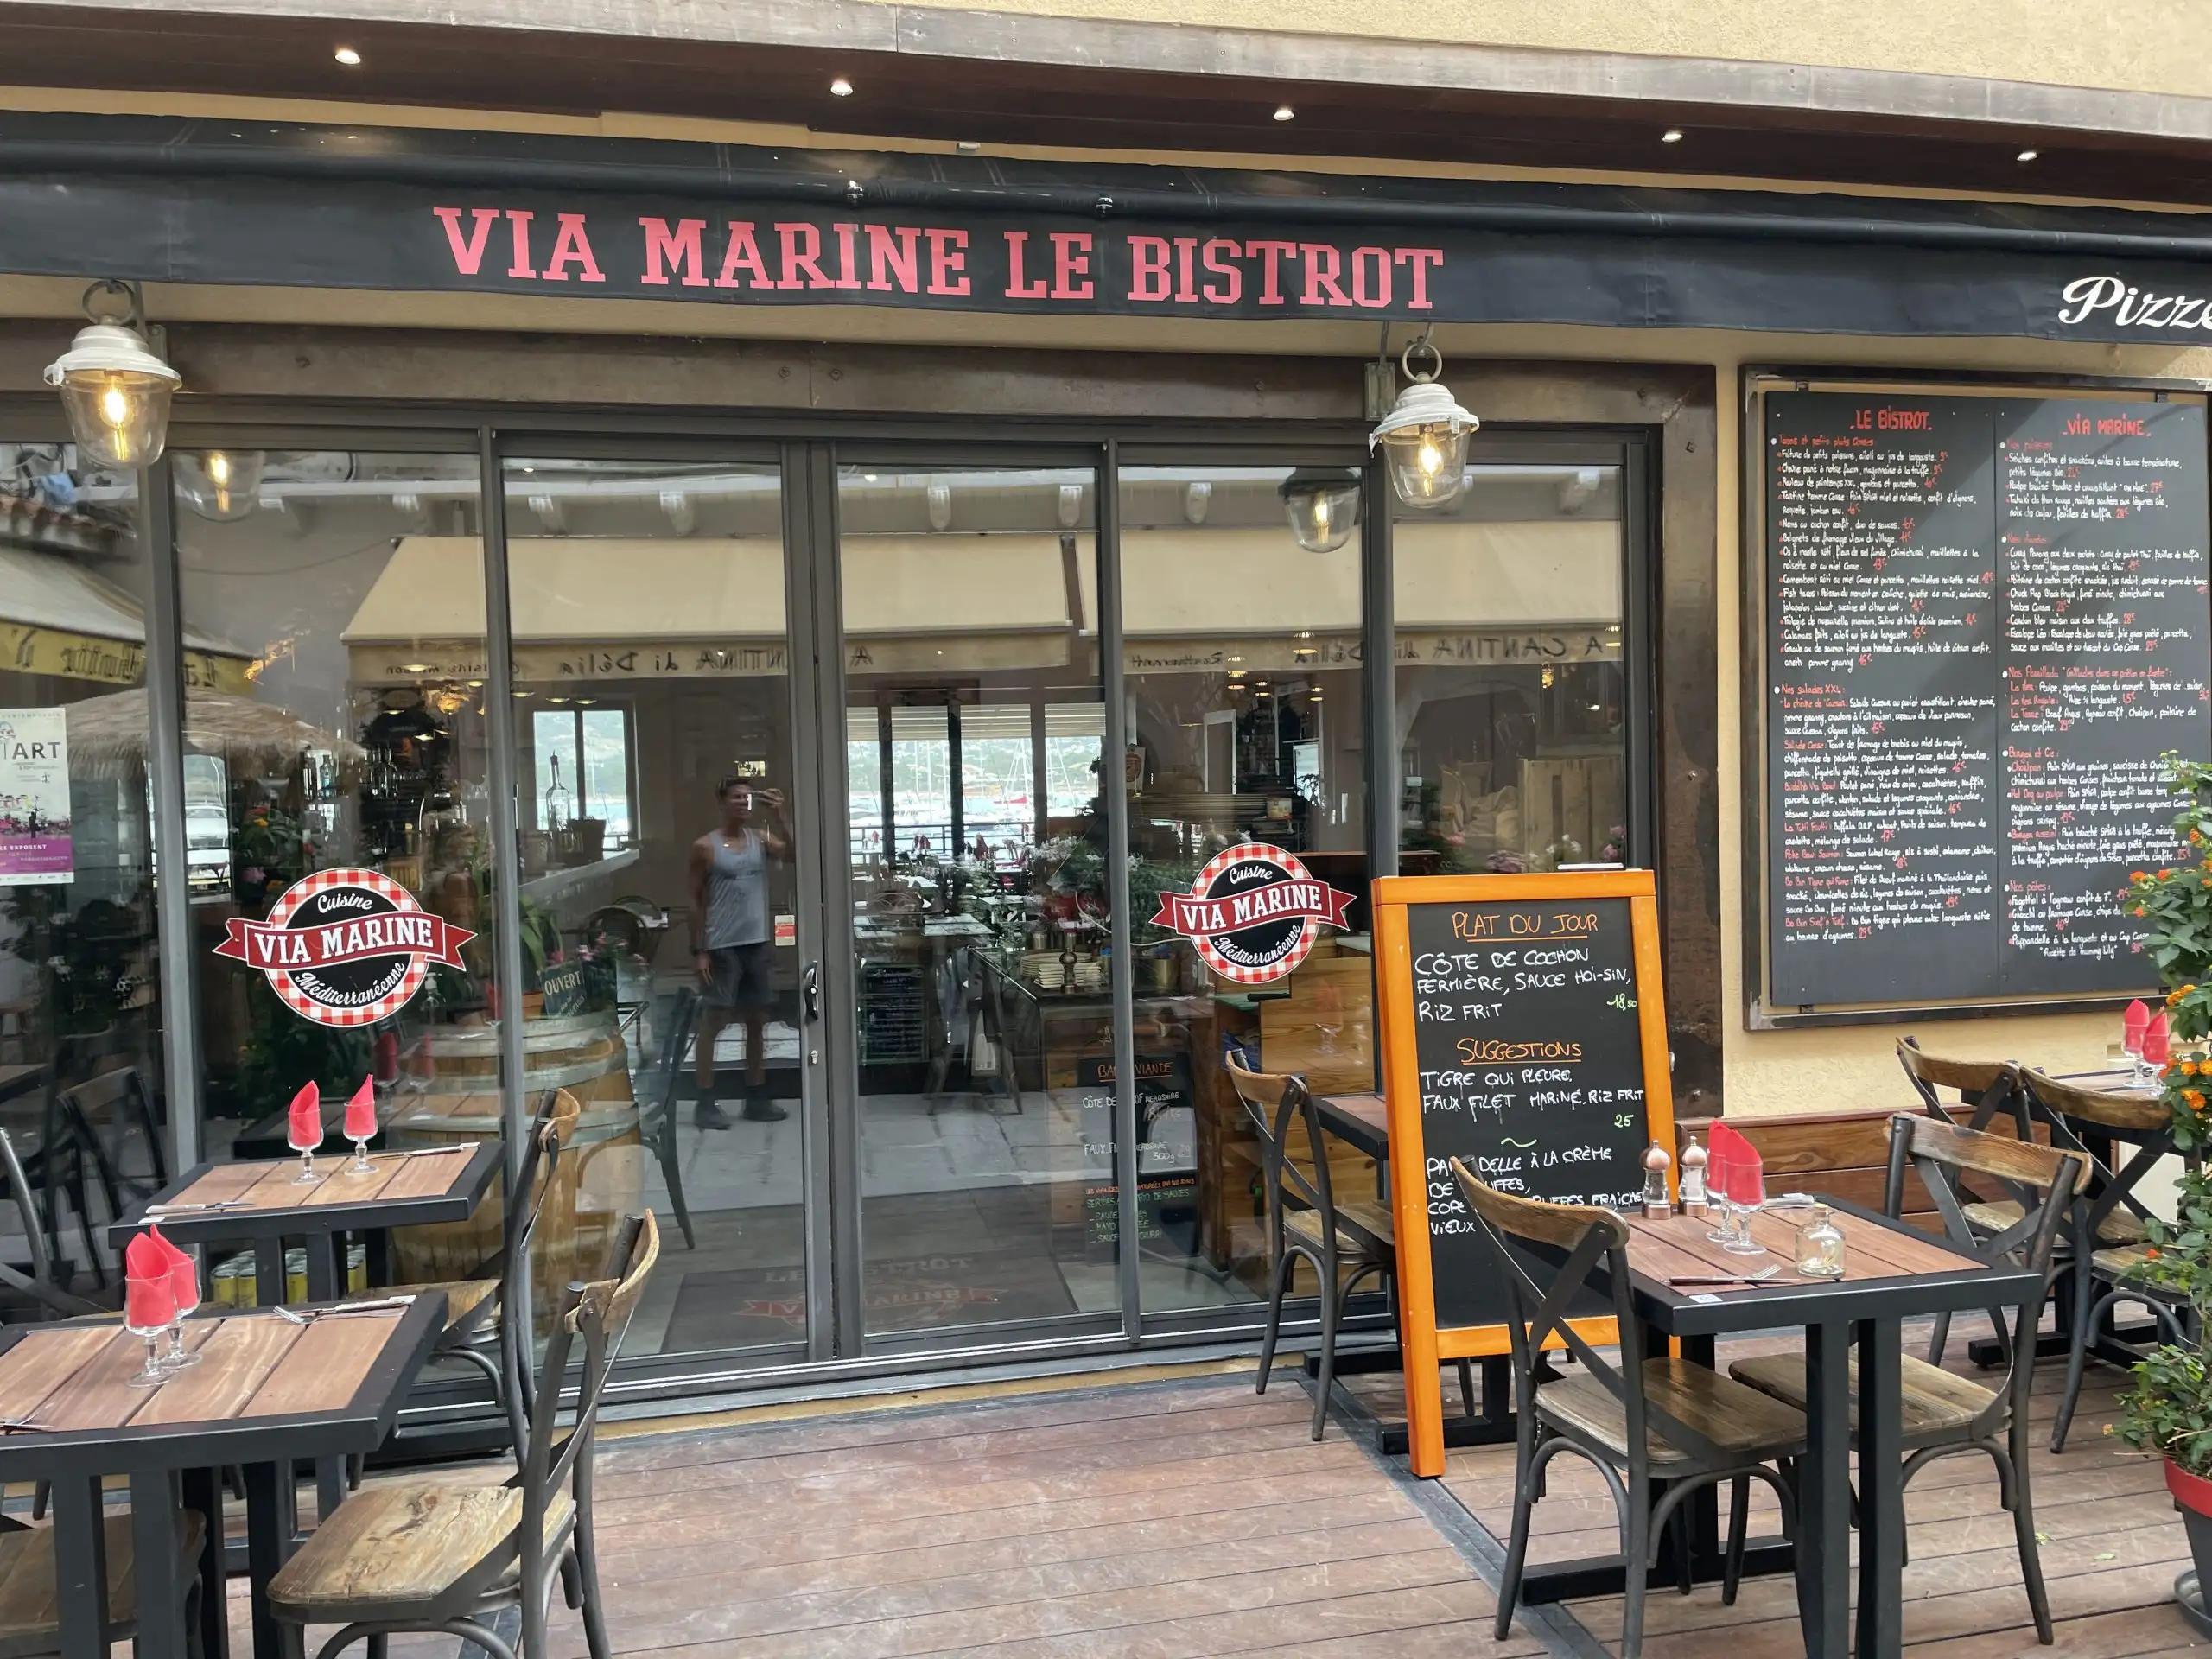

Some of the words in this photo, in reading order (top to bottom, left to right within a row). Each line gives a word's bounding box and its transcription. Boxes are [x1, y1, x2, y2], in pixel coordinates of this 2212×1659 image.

[434, 207, 606, 283] VIA
[639, 217, 971, 296] MARINE
[1003, 231, 1094, 300] LE
[1127, 235, 1444, 310] BISTROT
[1855, 410, 1872, 429] LE
[12, 741, 60, 760] ART
[1229, 865, 1273, 885] Cuisine
[317, 893, 372, 914] Cuisine
[1181, 902, 1226, 931] VIA
[1233, 884, 1322, 925] MARINE
[1452, 911, 1500, 939] PLAT
[1510, 914, 1541, 934] DU
[1550, 913, 1599, 934] JOUR
[255, 933, 313, 964] VIA
[321, 917, 435, 960] MARINE
[1214, 925, 1301, 966] Méditerranéenne
[1414, 952, 1479, 977] CÔTE
[1491, 954, 1517, 969] DE
[1524, 948, 1590, 965] COCHON
[294, 962, 405, 1007] Méditerranéenne
[544, 971, 581, 995] OUVERT
[1417, 974, 1510, 995] FERMIÈRE,
[1515, 972, 1566, 992] SAUCE
[1423, 1094, 1460, 1114] FAUX
[1614, 1114, 1634, 1128] 25
[1530, 1152, 1539, 1168] À
[1543, 1150, 1559, 1166] LA
[1561, 1145, 1612, 1164] CRÈME
[1428, 1182, 1454, 1198] DE
